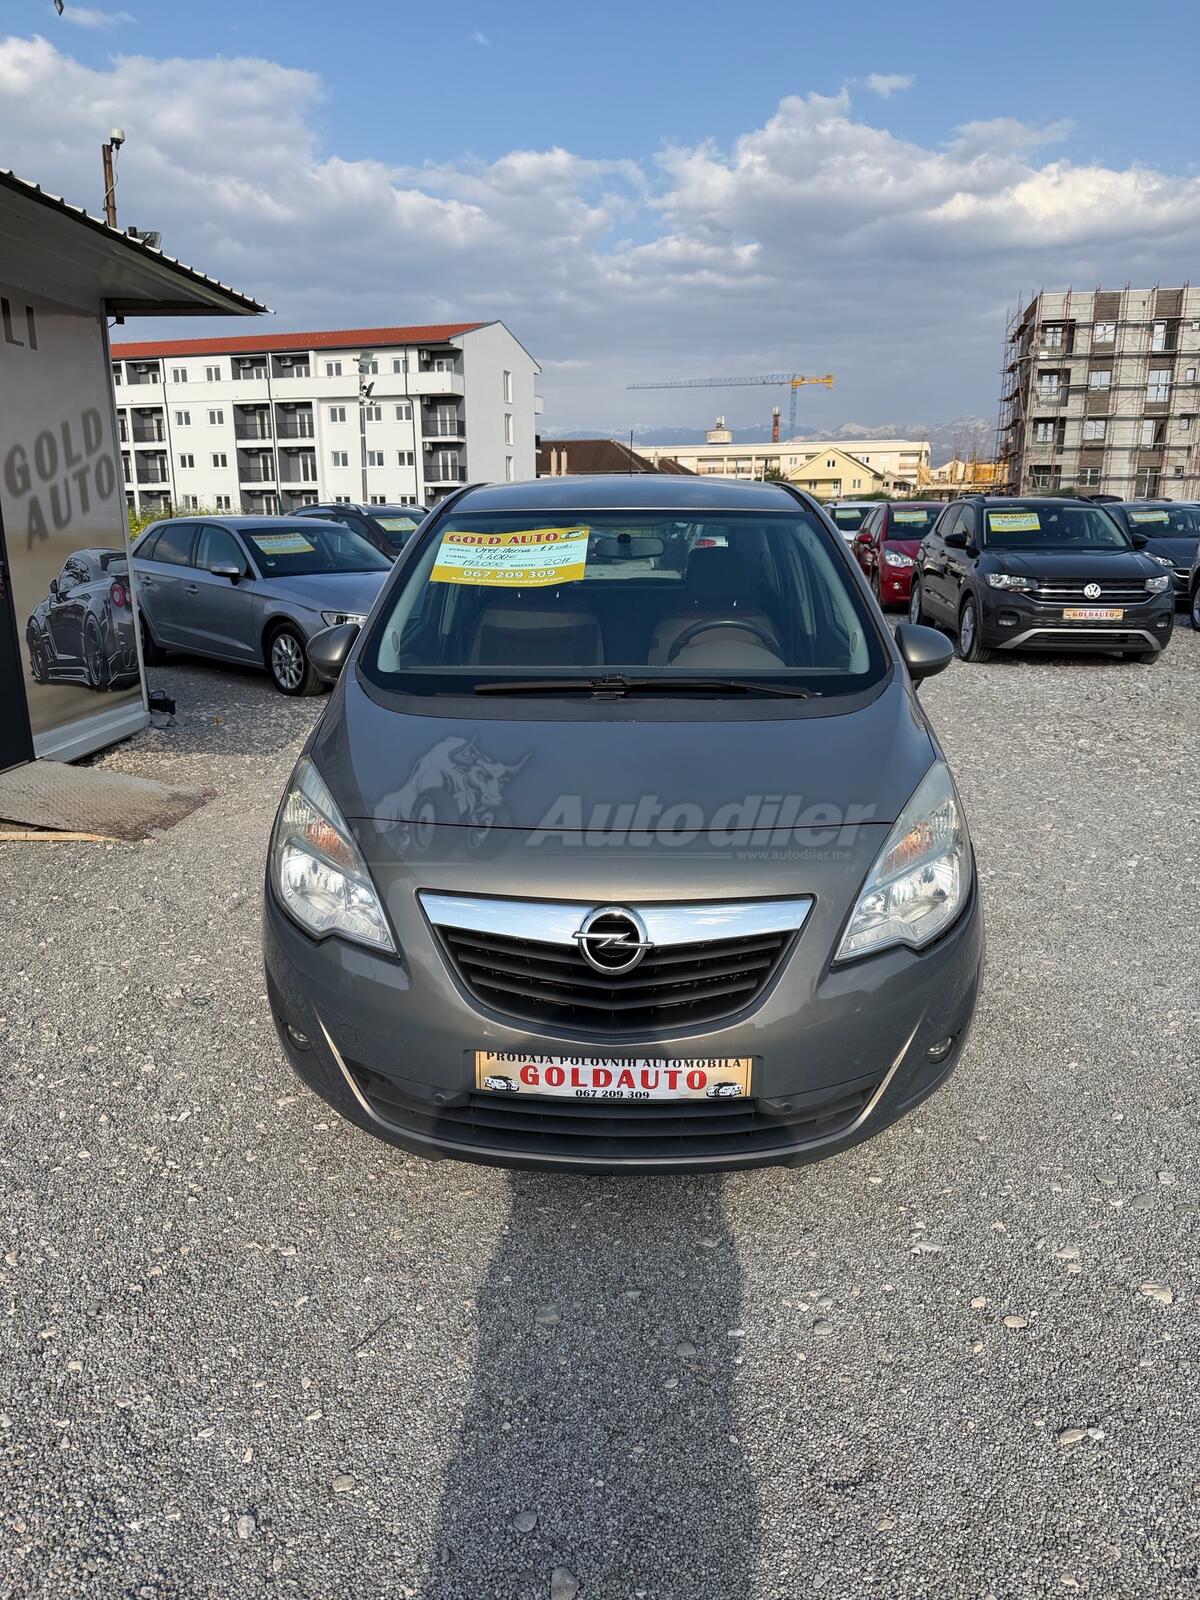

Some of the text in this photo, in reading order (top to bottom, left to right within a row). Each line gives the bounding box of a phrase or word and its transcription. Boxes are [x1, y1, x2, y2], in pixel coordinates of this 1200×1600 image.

[4, 407, 103, 499] GOLD
[26, 454, 115, 552] AUTO
[448, 532, 559, 545] GOLD AUTO
[543, 556, 571, 567] 2011
[463, 569, 557, 579] 067 209 309
[486, 1051, 742, 1069] PRODAJA POLOVNIH AUTOMOBILA
[519, 1064, 708, 1091] GOLDAUTO
[575, 1089, 650, 1099] 067 209 309
